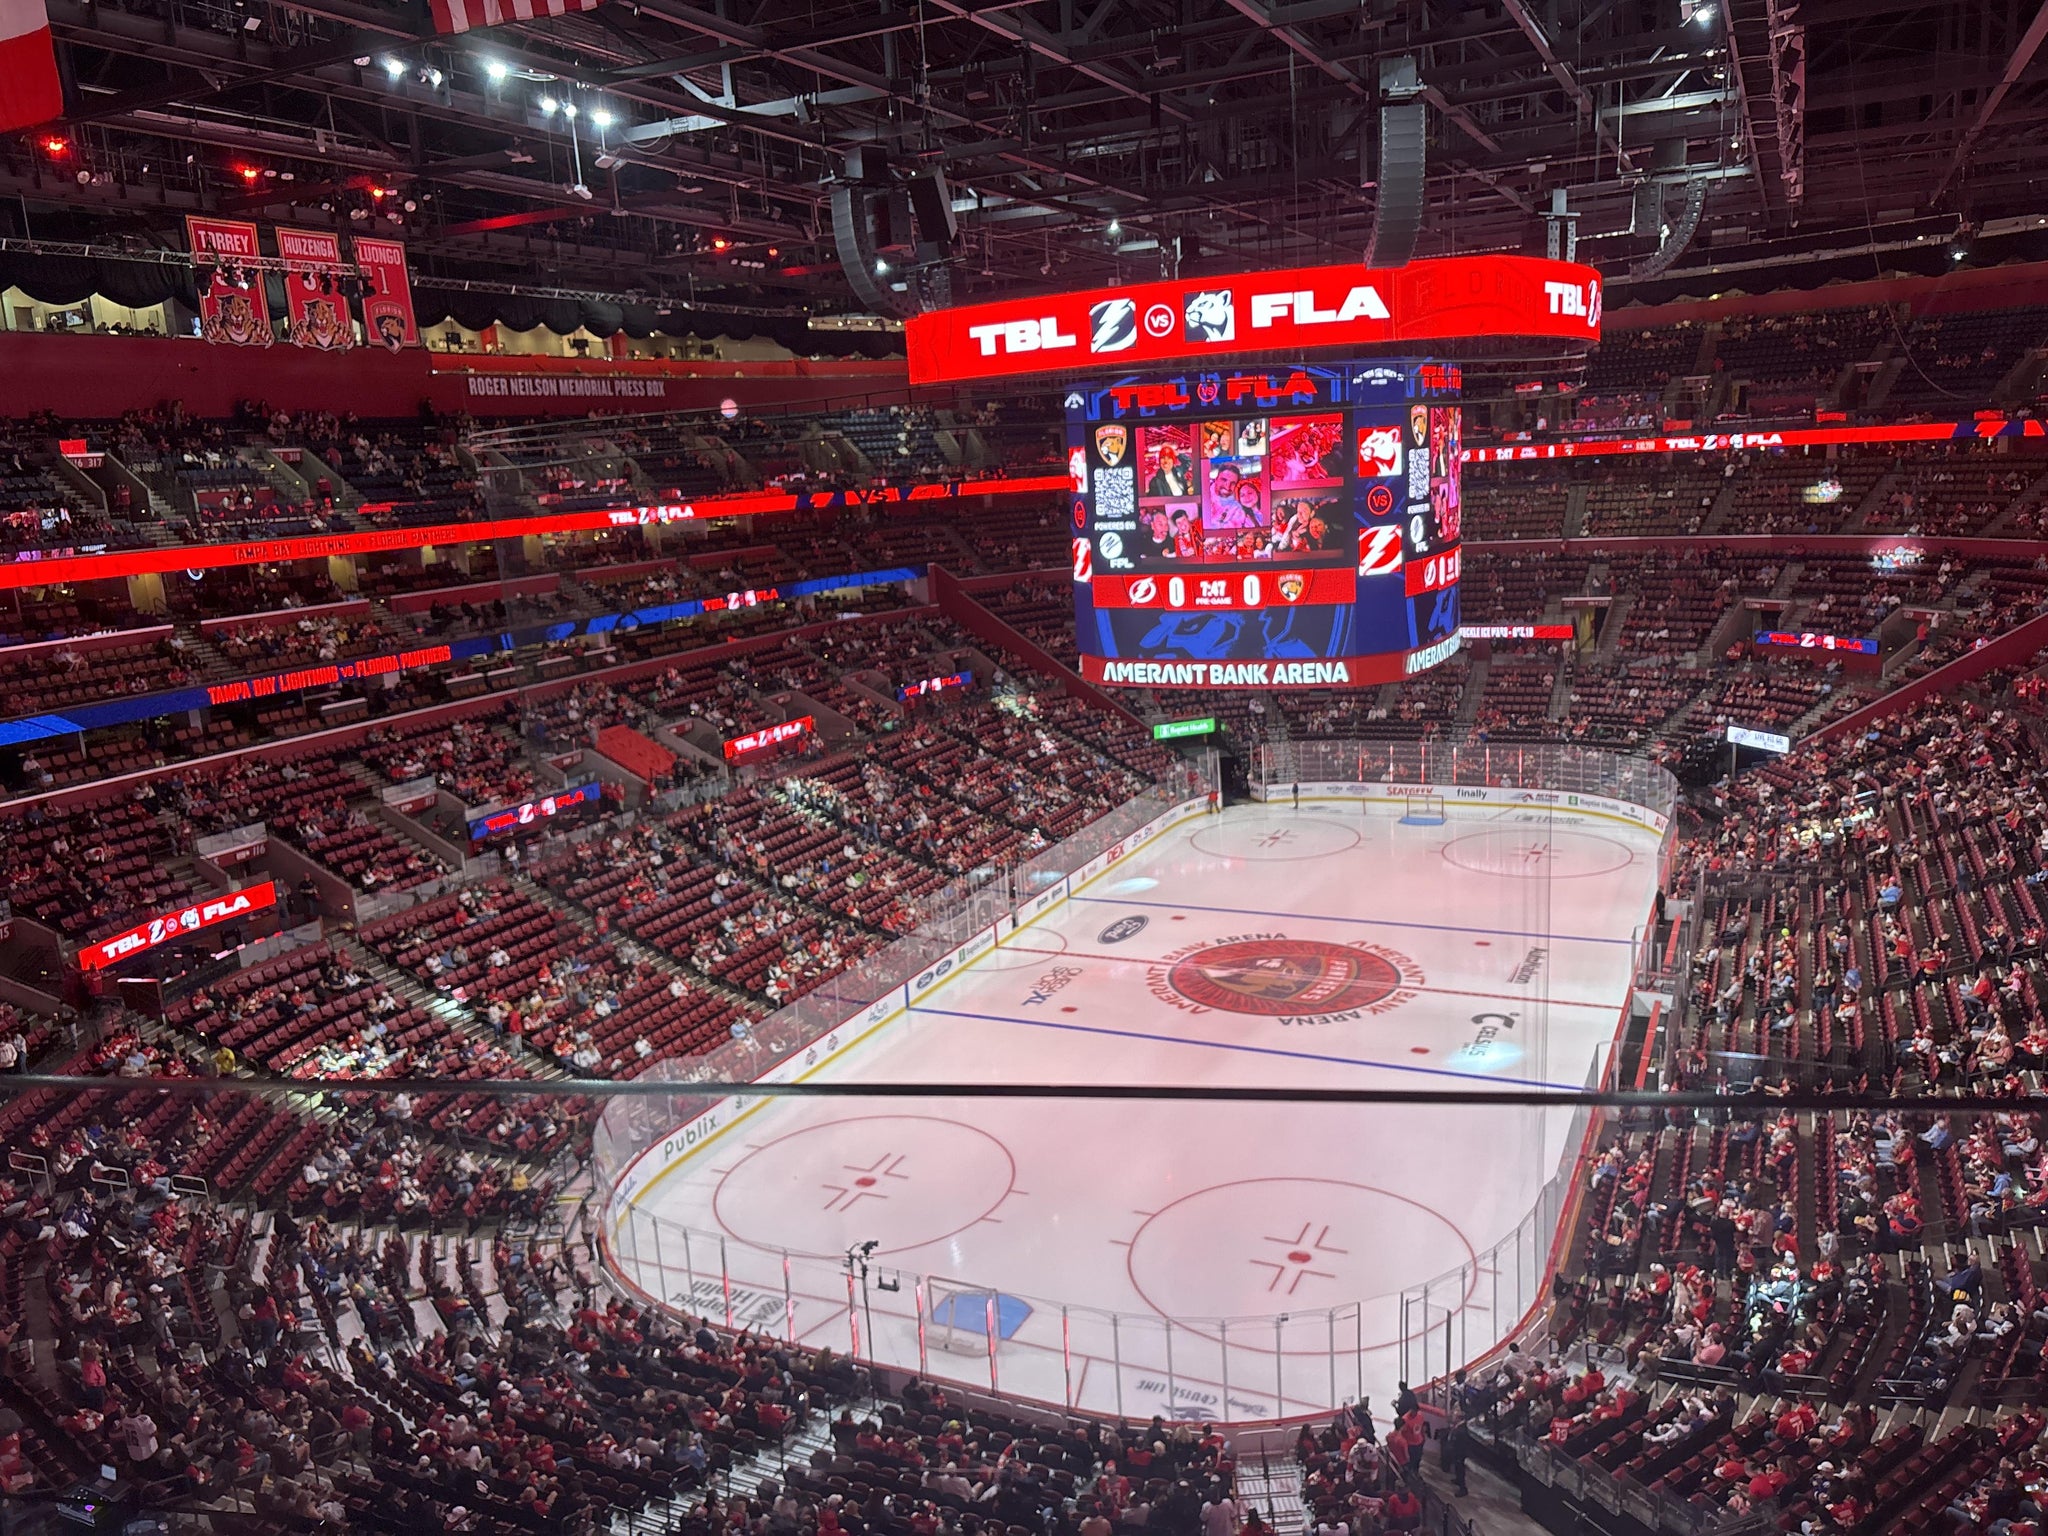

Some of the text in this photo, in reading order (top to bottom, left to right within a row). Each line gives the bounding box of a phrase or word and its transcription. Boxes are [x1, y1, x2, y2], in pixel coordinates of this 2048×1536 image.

[198, 230, 249, 253] TORREY
[283, 236, 335, 258] HUIZENGA
[358, 245, 401, 265] LUONGO
[377, 267, 390, 295] 1
[1252, 286, 1391, 328] FLA
[1544, 281, 1587, 316] TBL
[1150, 314, 1169, 328] VS
[969, 316, 1077, 356] TBL
[468, 377, 665, 397] ROGER NEILSON MEMORIAL PRESS BOX
[1110, 383, 1190, 409] TBL
[1227, 371, 1318, 400] FLA
[1746, 433, 1783, 446] FLA
[668, 505, 695, 519] FLA
[1373, 495, 1387, 508] VS
[1168, 577, 1185, 608] 0
[1200, 580, 1227, 598] 7:47
[1243, 575, 1261, 606] 0
[207, 682, 251, 705] TAMPA
[252, 677, 276, 697] BAY
[279, 665, 340, 692] LIGHTNING
[355, 655, 399, 678] FLORIDA
[400, 645, 452, 669] PANTHERS
[1103, 661, 1349, 685] AMERANT BANK ARENA
[1456, 787, 1488, 800] finally
[102, 895, 251, 958] TBL FLA
[1146, 932, 1287, 1015] AMERANT BANK ARENA
[1278, 939, 1426, 1026] AMERANT BANK ARENA
[1470, 1026, 1499, 1057] CELSIUS
[664, 1115, 717, 1161] Publix
[669, 1291, 740, 1316] Baptist
[691, 1280, 754, 1303] Health
[1135, 1379, 1168, 1394] LINE
[1171, 1387, 1219, 1406] CRUISE
